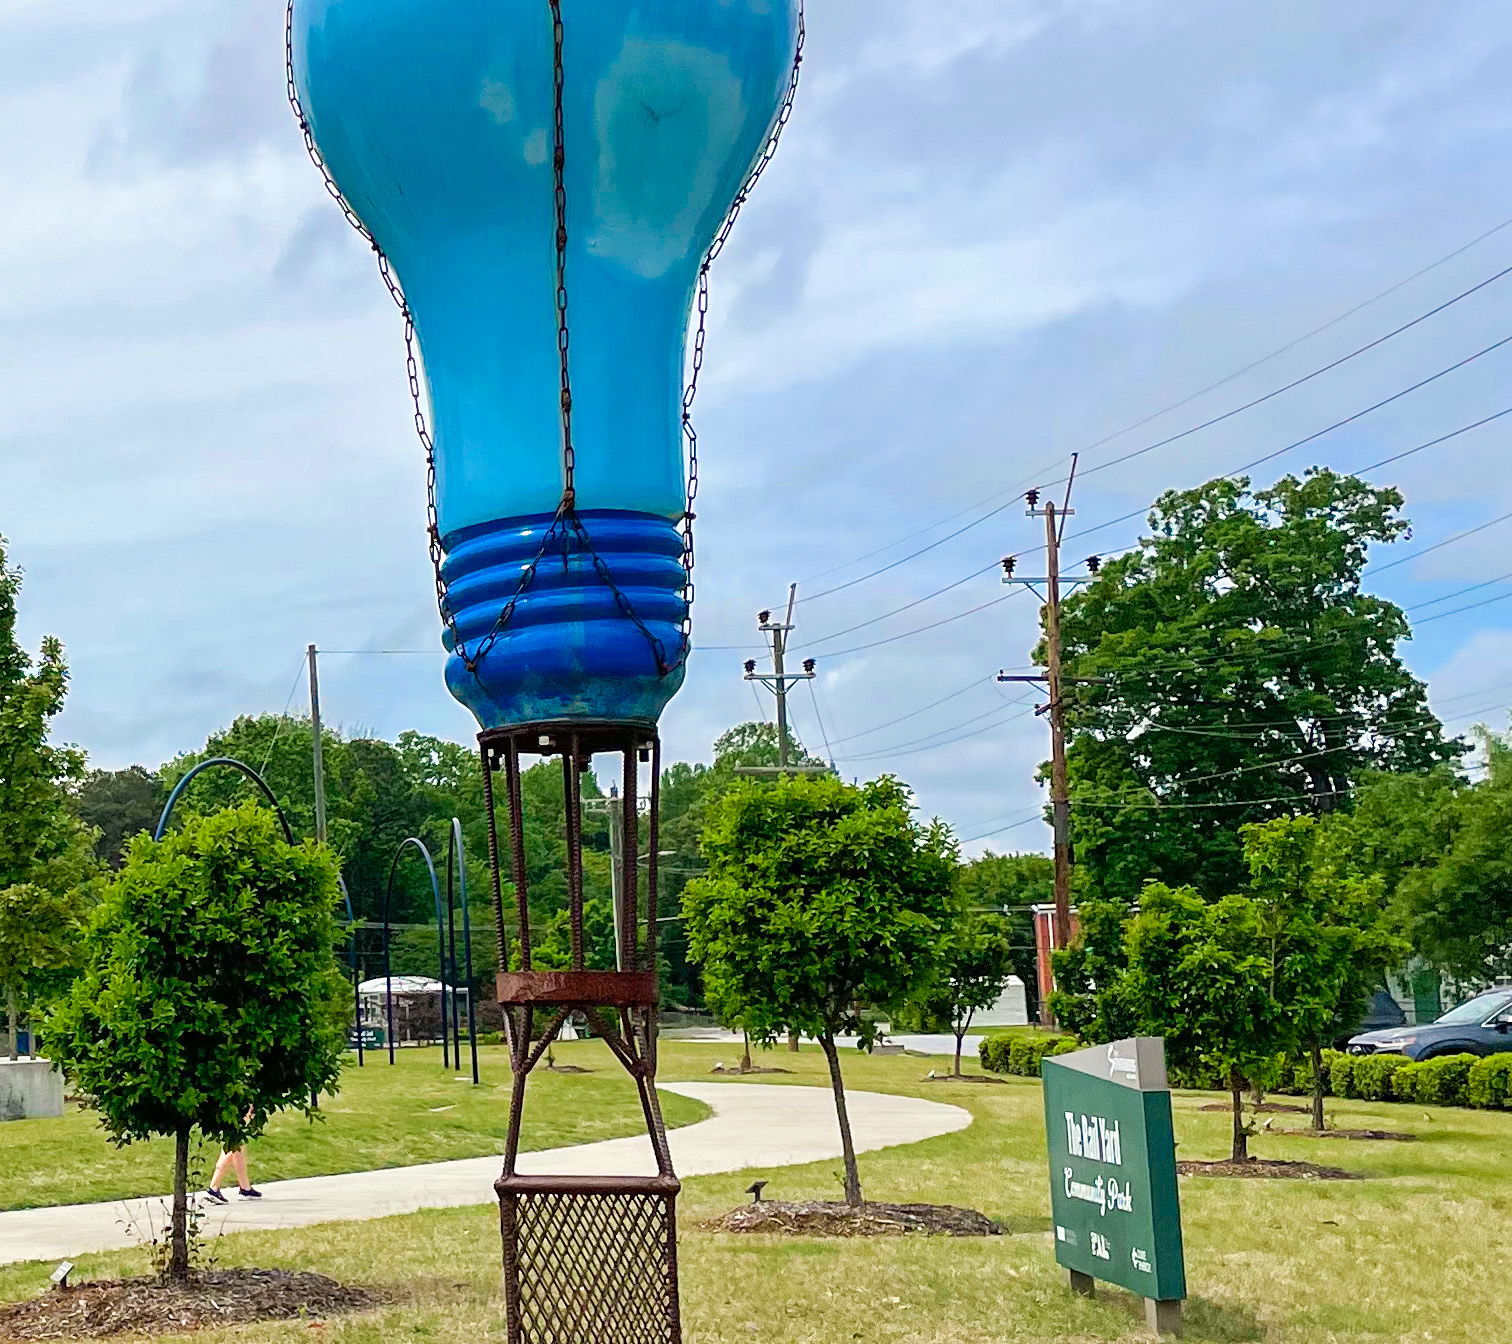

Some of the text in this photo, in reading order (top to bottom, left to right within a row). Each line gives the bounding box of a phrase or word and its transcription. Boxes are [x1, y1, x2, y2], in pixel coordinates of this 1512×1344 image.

[1065, 1111, 1122, 1166] The Rail Yard
[1064, 1167, 1133, 1217] Community Park
